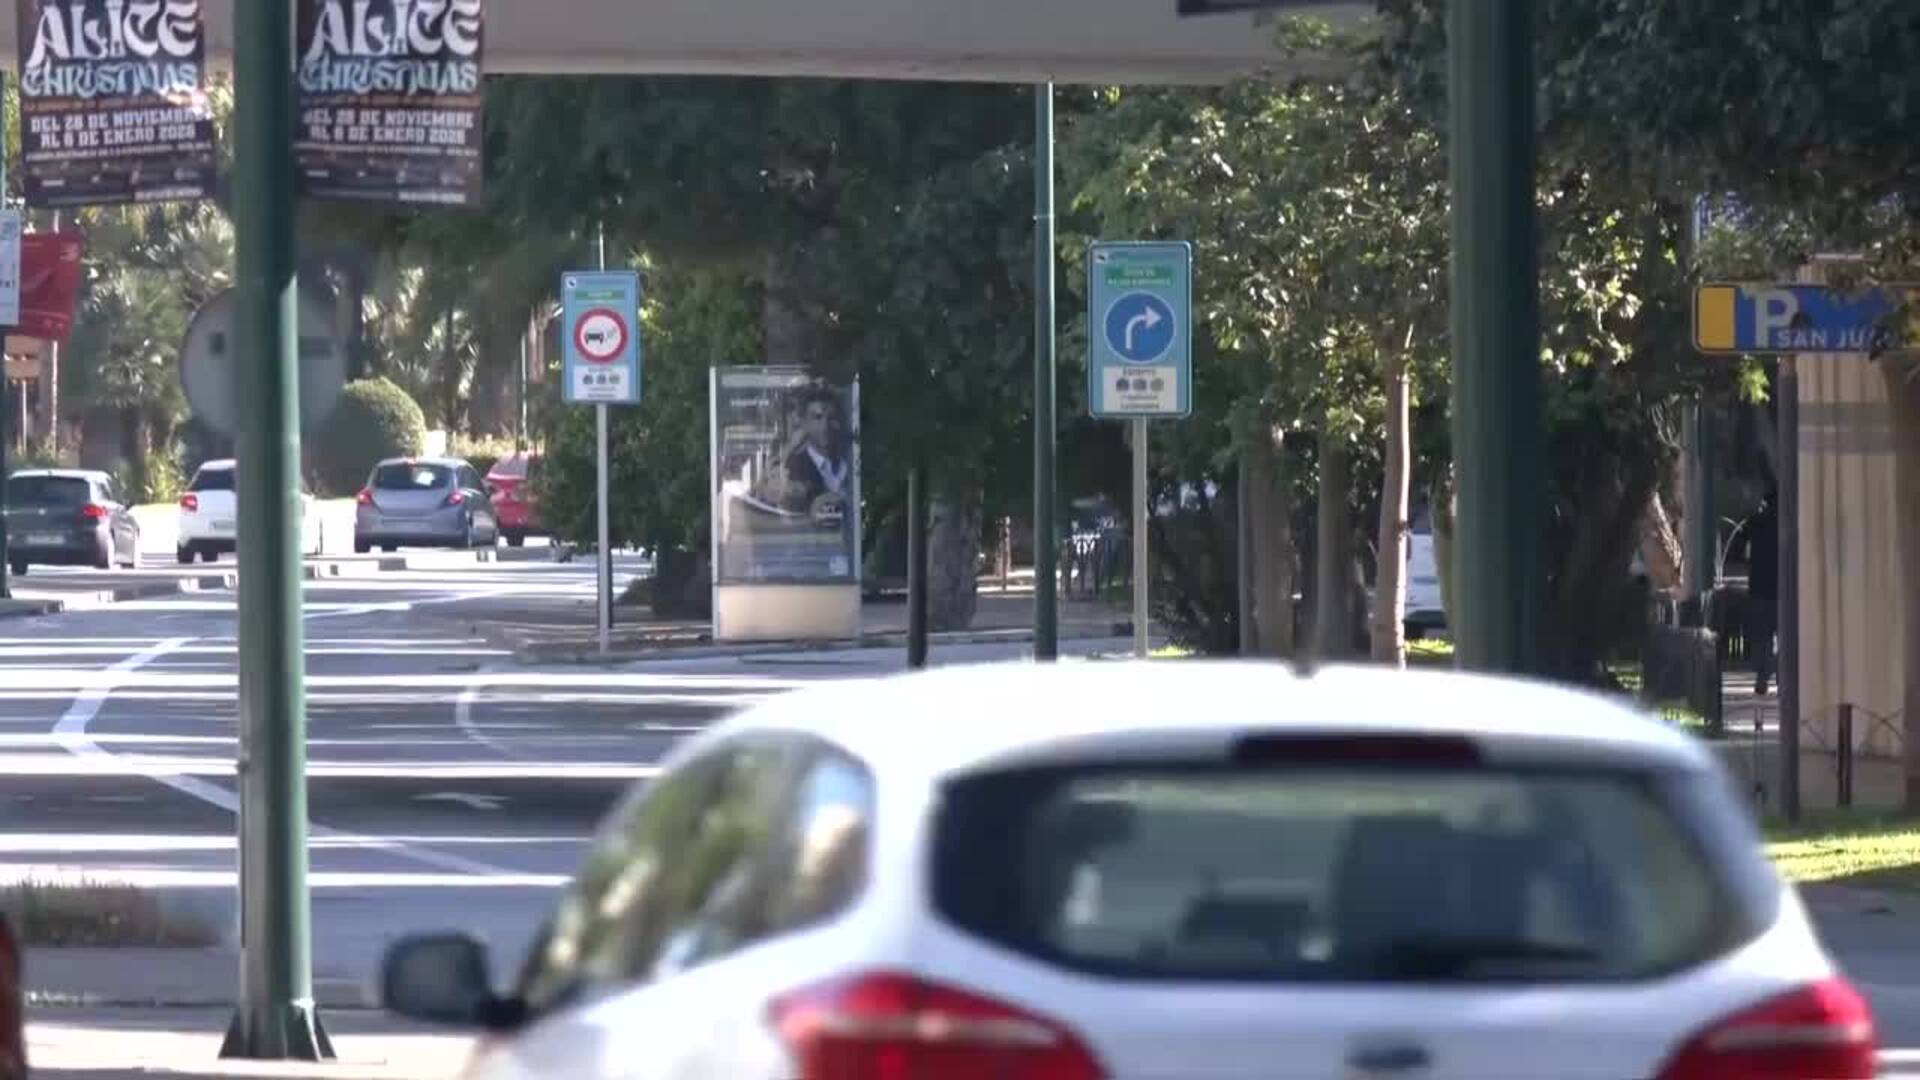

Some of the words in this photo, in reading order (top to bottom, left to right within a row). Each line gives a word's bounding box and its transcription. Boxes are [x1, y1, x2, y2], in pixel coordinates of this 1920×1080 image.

[24, 0, 198, 67] ALICE
[304, 0, 479, 61] ALICE
[21, 56, 197, 98] CHRISTMAS
[299, 53, 477, 96] CHRISTMAS
[30, 116, 61, 133] DEL
[88, 112, 109, 129] DE
[348, 126, 369, 142] DE
[373, 127, 425, 143] ENERO
[359, 109, 381, 126] DE
[385, 110, 474, 129] NOVIEMBRE
[41, 131, 61, 149] AL
[78, 130, 99, 146] DE
[103, 127, 155, 145] ENERO
[1755, 289, 1799, 348] P
[1777, 330, 1828, 348] SAN
